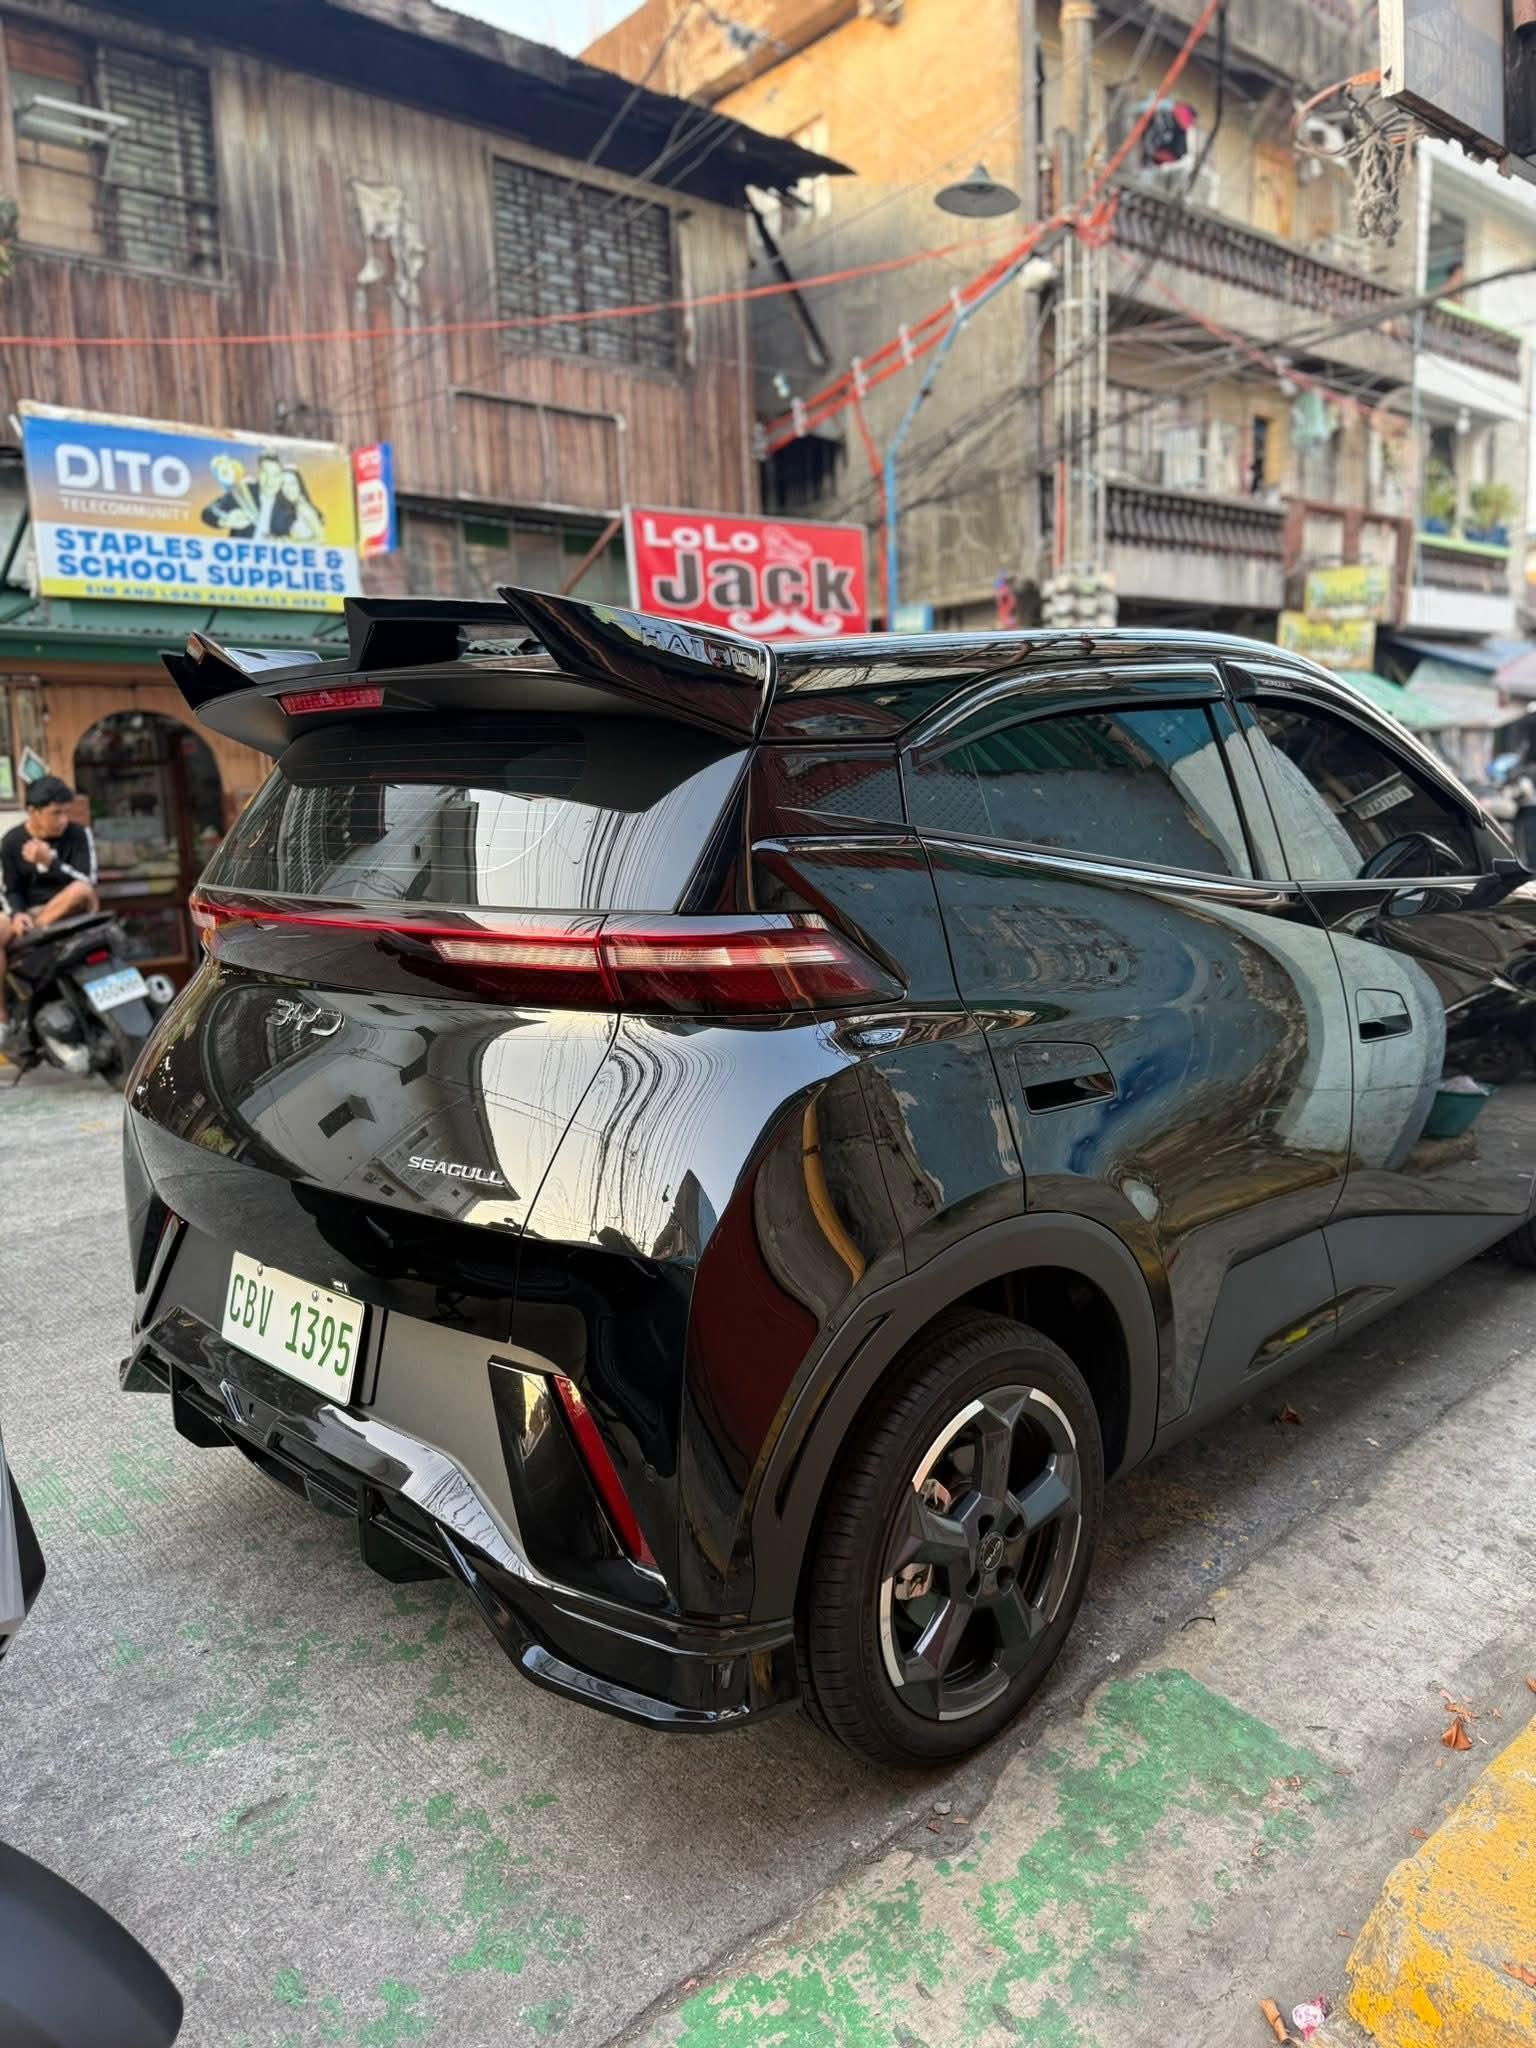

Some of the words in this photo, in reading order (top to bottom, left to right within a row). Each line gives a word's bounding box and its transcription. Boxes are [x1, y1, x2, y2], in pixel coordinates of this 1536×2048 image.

[55, 443, 191, 498] DITO
[62, 499, 192, 521] TELECOMMUNITY
[55, 528, 202, 560] STAPLES
[213, 542, 317, 568] OFFICE
[325, 550, 344, 570] &
[58, 554, 197, 583] SCHOOL
[207, 565, 346, 593] SUPPLIES
[122, 586, 156, 597] AND
[652, 548, 859, 614] Jack
[407, 1155, 506, 1188] SEAGULL
[229, 1272, 275, 1337] CBV
[284, 1300, 353, 1377] 1395
